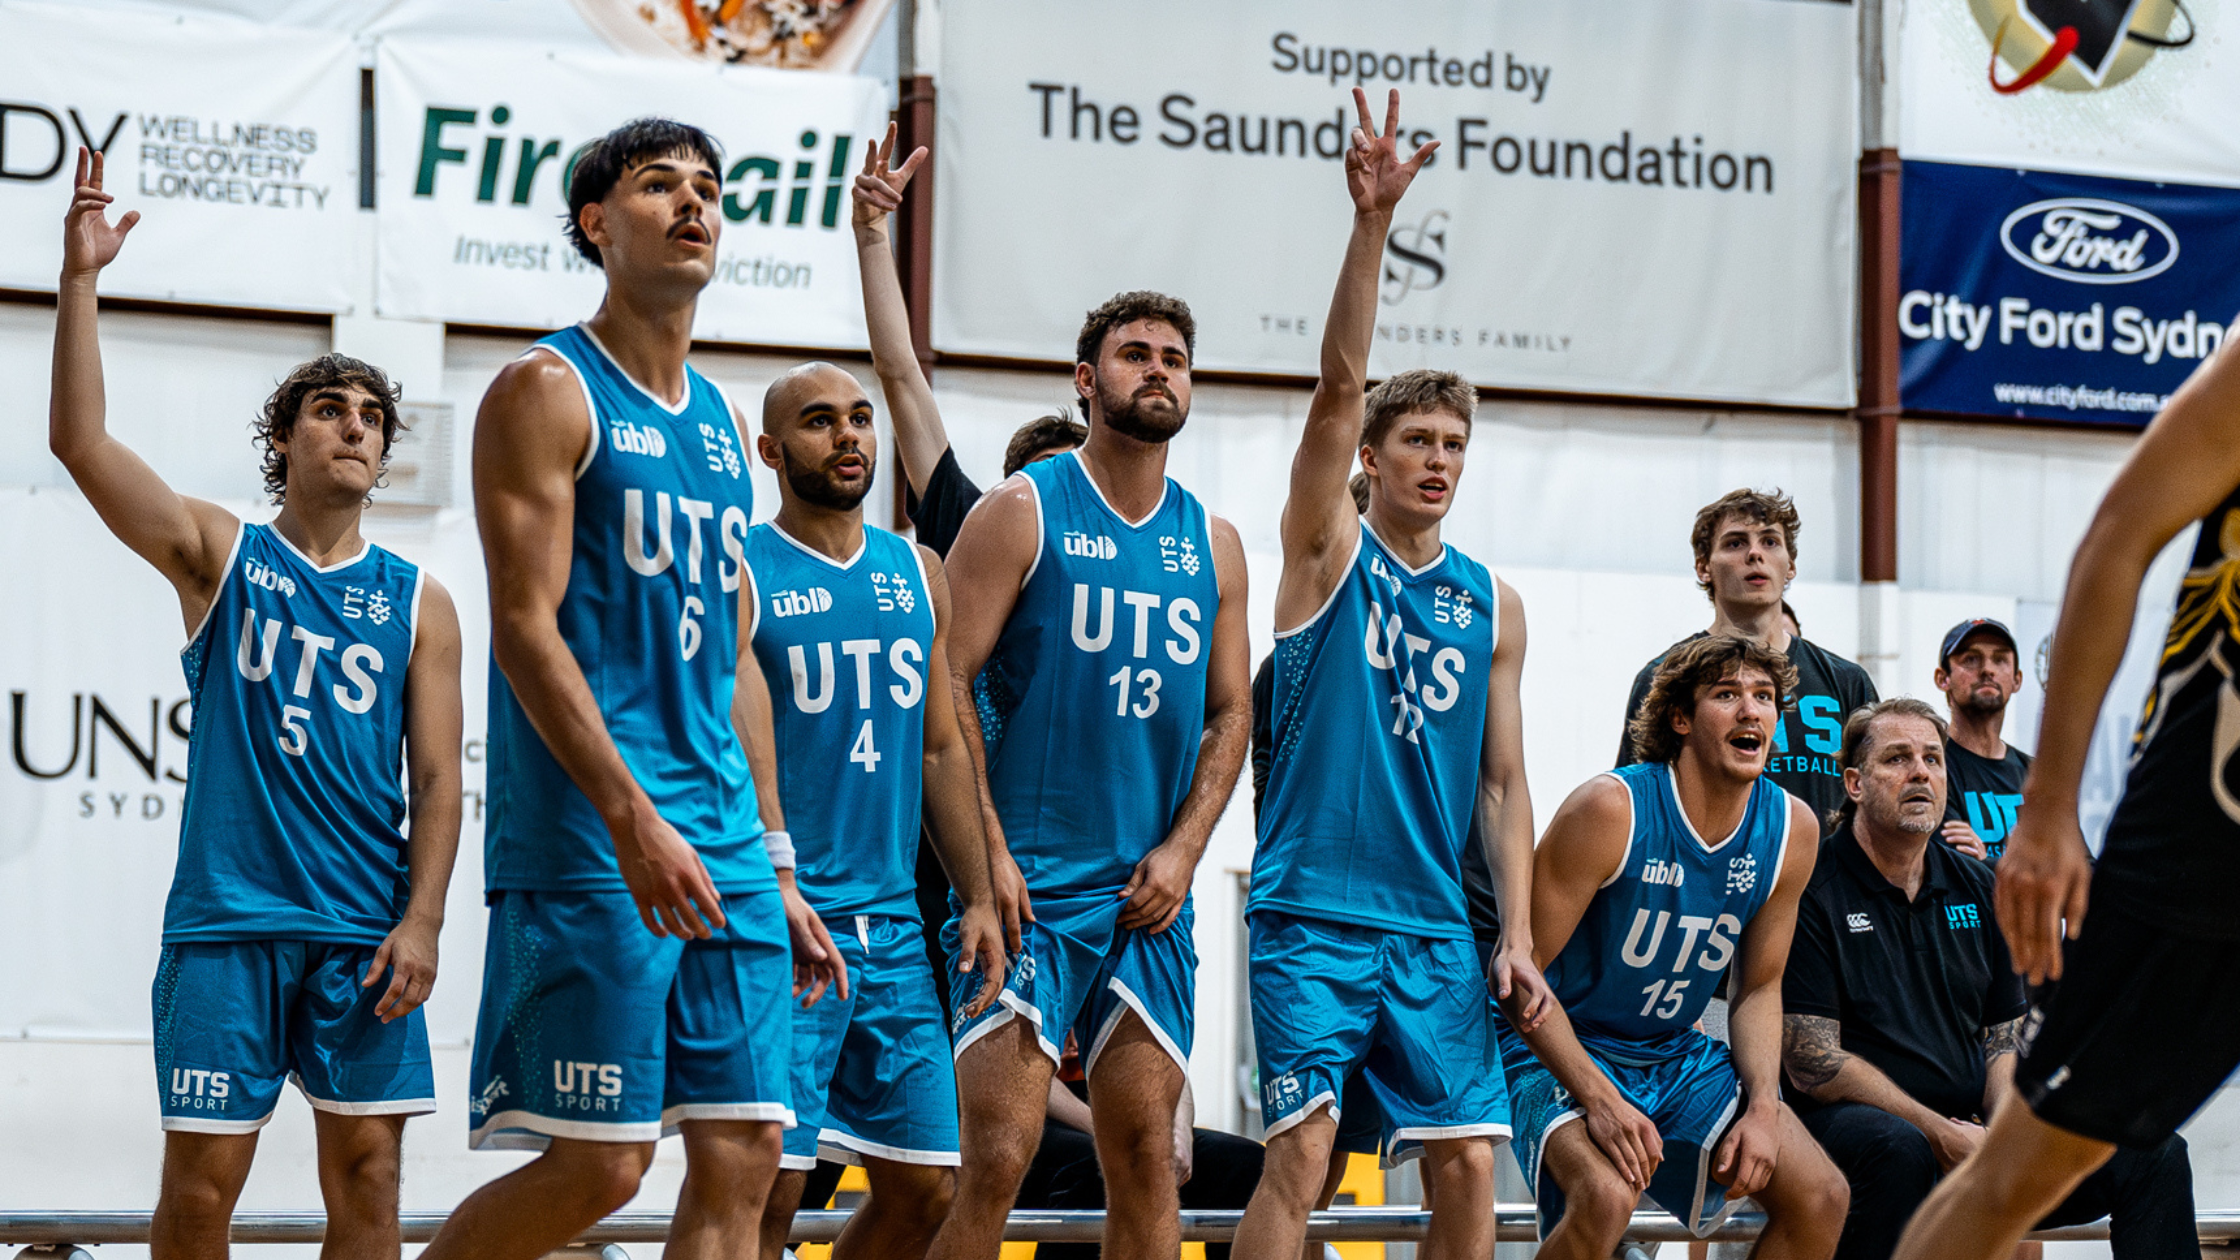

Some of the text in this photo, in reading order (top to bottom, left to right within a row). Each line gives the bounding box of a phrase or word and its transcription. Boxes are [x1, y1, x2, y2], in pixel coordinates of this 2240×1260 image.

[1272, 32, 1551, 103] Supported by
[138, 113, 318, 153] WELLNESS
[1028, 82, 1139, 145] The
[1456, 117, 1775, 193] Foundation
[138, 144, 305, 178] RECOVERY
[138, 172, 330, 209] LONGEVITY
[454, 234, 551, 271] Invest
[2030, 208, 2149, 272] Ford
[1259, 313, 1308, 336] THE
[1477, 328, 1572, 351] FAMILY
[1898, 289, 2226, 364] City Ford Sydn
[698, 422, 724, 473] UTS
[623, 489, 748, 594] UTS
[1159, 535, 1179, 573] UTS
[342, 585, 365, 619] UTS
[870, 572, 895, 612] UTS
[1434, 585, 1452, 624] UTS
[678, 595, 706, 662] 6
[1071, 583, 1202, 666] UTS
[237, 607, 384, 715] UTS
[787, 637, 924, 714] UTS
[1364, 600, 1467, 713] UTS
[1108, 665, 1163, 720] 13
[278, 704, 312, 756] 5
[850, 718, 881, 773] 4
[1944, 903, 1978, 922] UTS
[1949, 920, 1981, 930] SPORT
[1621, 907, 1742, 973] UTS
[1640, 978, 1691, 1020] 15
[171, 1067, 230, 1098] UTS
[554, 1060, 623, 1097] UTS
[1265, 1070, 1300, 1106] UTS
[171, 1095, 228, 1111] SPORT
[554, 1093, 621, 1111] SPORT
